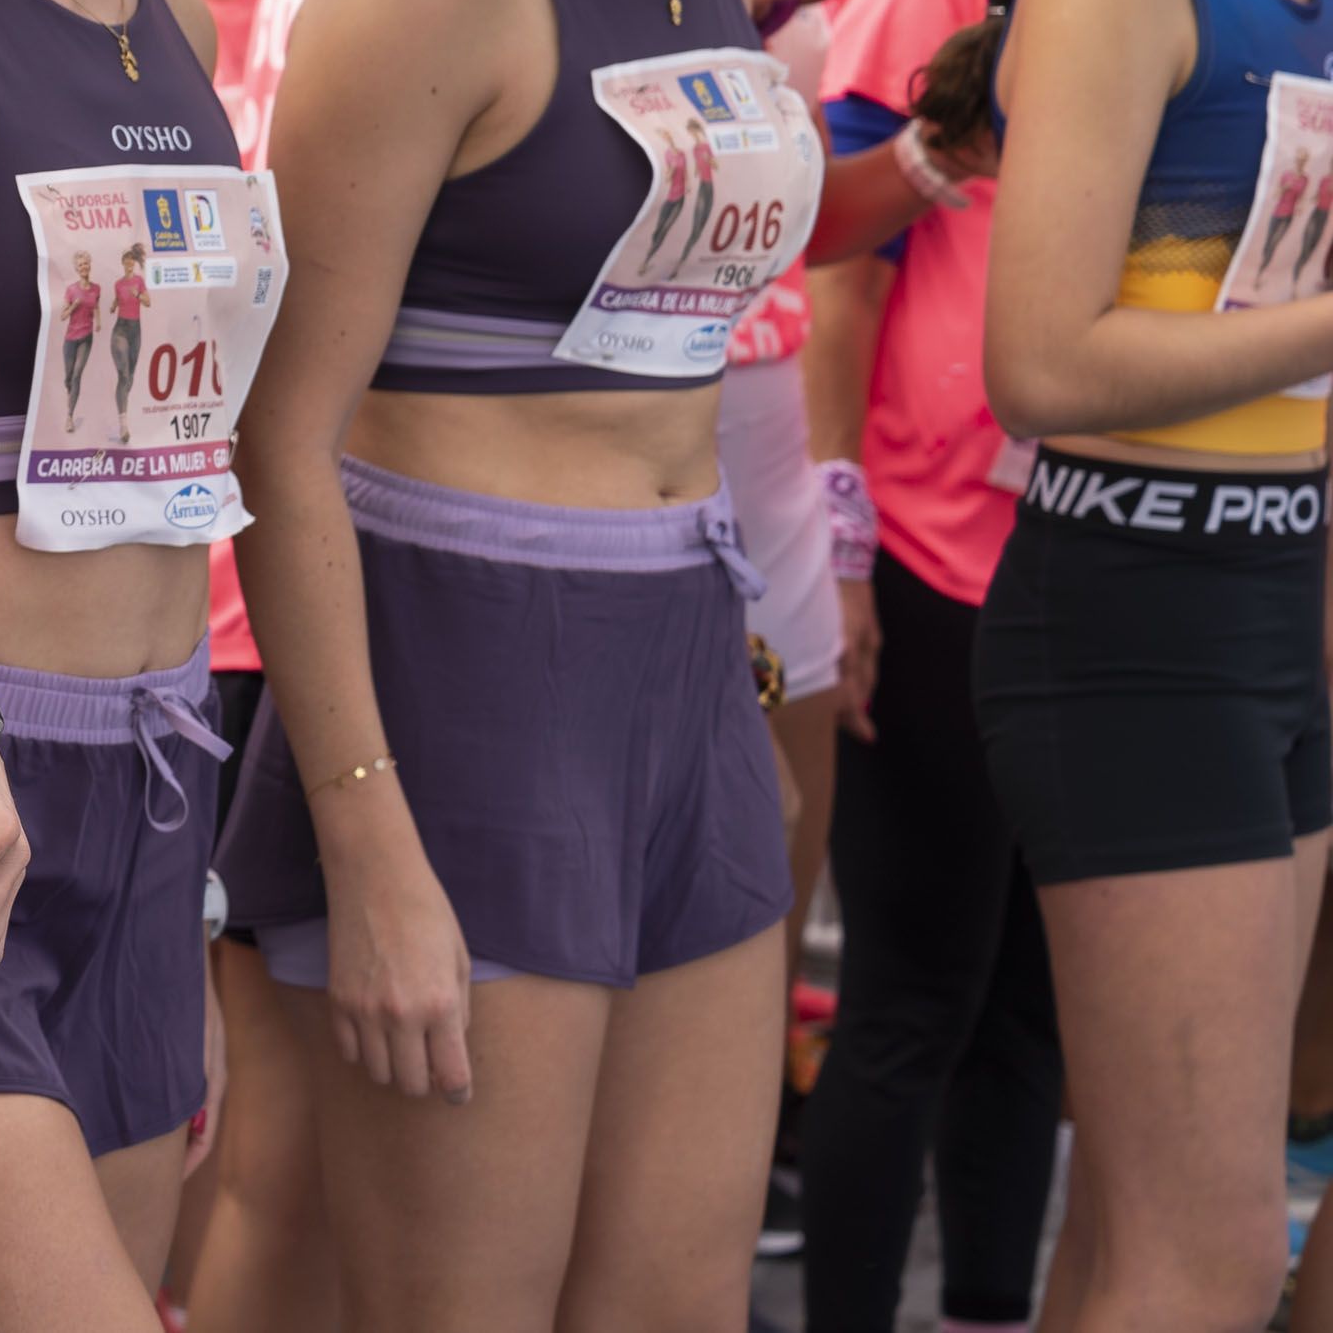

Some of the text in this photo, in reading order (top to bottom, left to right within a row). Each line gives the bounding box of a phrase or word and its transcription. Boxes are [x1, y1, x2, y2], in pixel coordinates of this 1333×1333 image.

[111, 124, 192, 152] OYSHO
[77, 191, 129, 208] DORSAL
[64, 207, 133, 232] SUMA
[710, 200, 784, 253] 016
[170, 411, 212, 440] 1907
[37, 457, 115, 478] CARRERA
[120, 457, 146, 476] DE
[149, 455, 167, 475] LA
[1027, 461, 1320, 534] NIKE PRO
[61, 509, 126, 527] OYSHO
